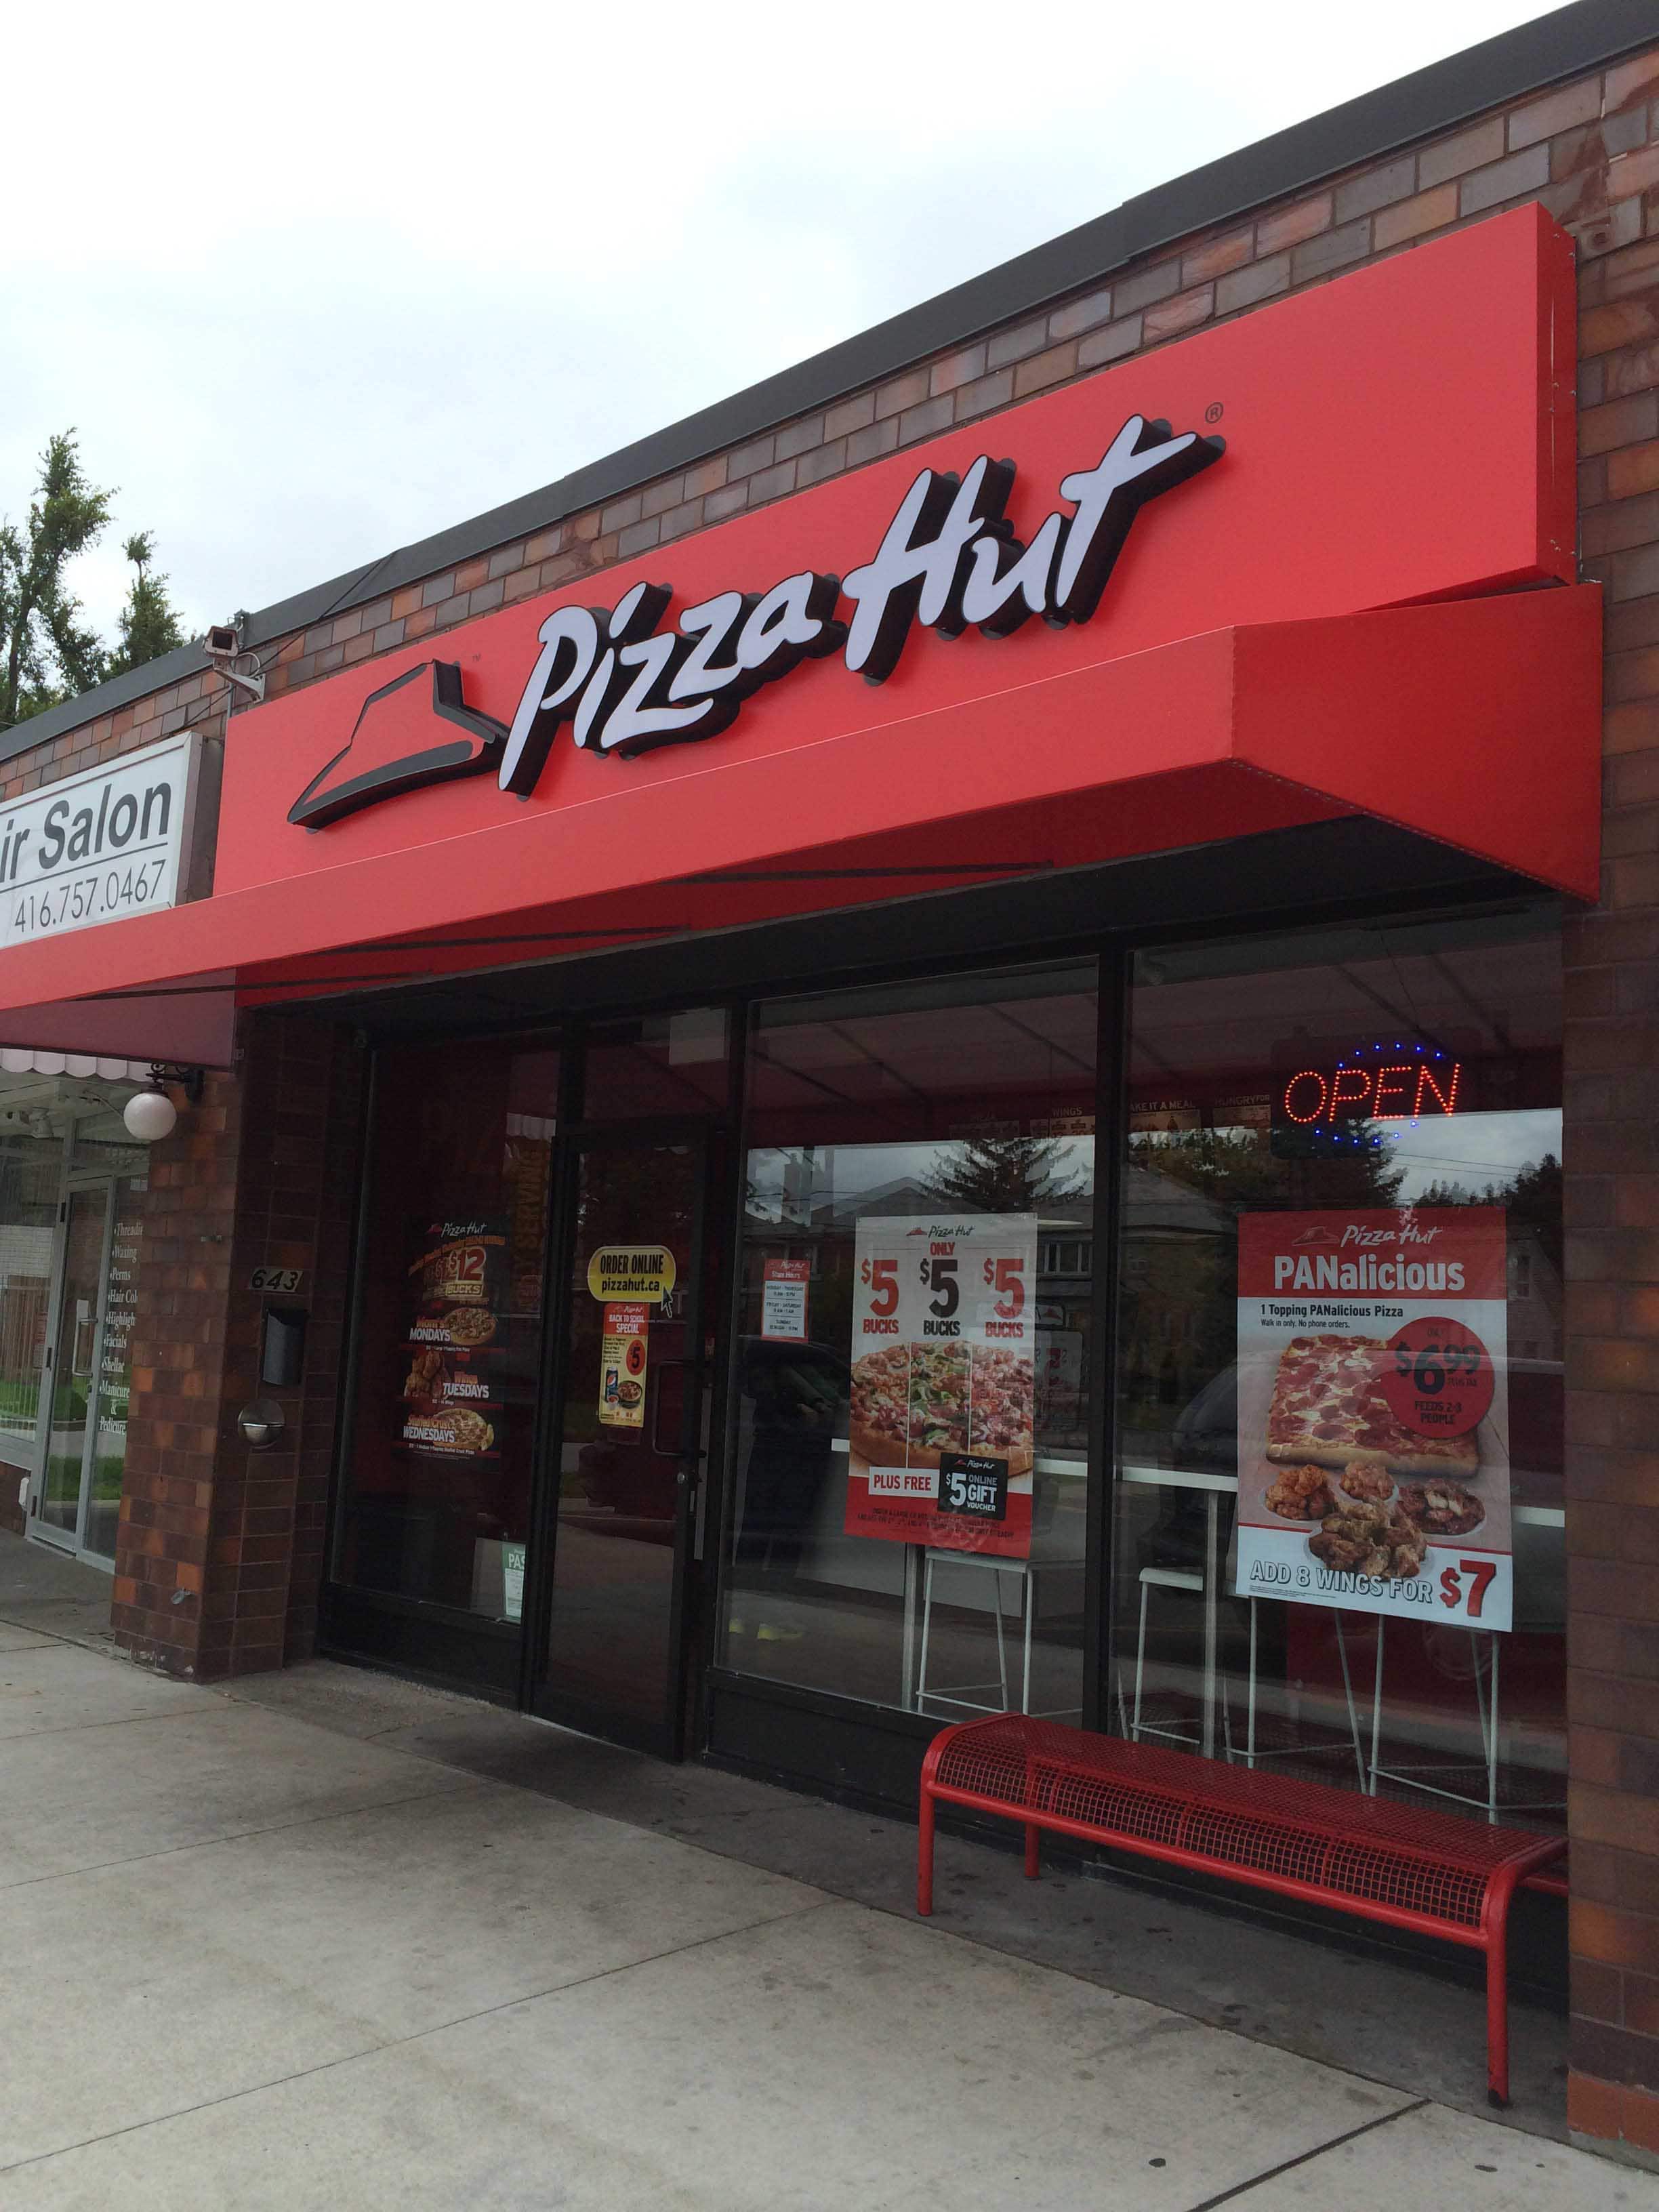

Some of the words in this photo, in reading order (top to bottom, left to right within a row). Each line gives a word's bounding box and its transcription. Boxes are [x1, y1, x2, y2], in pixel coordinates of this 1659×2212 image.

[498, 570, 837, 796] Pizza
[842, 414, 1210, 678] Hut
[39, 782, 171, 869] Salon
[15, 859, 166, 933] 416.757.0467
[1285, 1062, 1461, 1123] OPEN
[1128, 1102, 1148, 1112] AKE
[441, 1221, 465, 1237] Pizza
[466, 1221, 487, 1235] Hut
[928, 1225, 954, 1237] Pizza
[955, 1225, 975, 1236] Hut
[1340, 1225, 1395, 1248] Pizza
[1396, 1223, 1443, 1245] Hut
[114, 1246, 137, 1263] Waxing
[930, 1242, 956, 1256] ONLY
[600, 1255, 629, 1275] ORDER
[632, 1254, 663, 1274] ONLINE
[1274, 1254, 1465, 1291] PANalicious
[112, 1267, 130, 1281] Perms
[251, 1269, 298, 1290] 643
[447, 1284, 480, 1295] BUCKS
[602, 1277, 659, 1294] pizzahut.ca
[861, 1258, 899, 1317] $5
[920, 1258, 960, 1318] $5
[984, 1258, 1025, 1319] $5
[110, 1289, 125, 1303] Hair
[609, 1314, 622, 1322] BACK
[623, 1314, 629, 1322] TO
[1261, 1304, 1265, 1315] 1
[1269, 1304, 1307, 1317] Topping
[1310, 1305, 1371, 1317] PANalicious
[1374, 1305, 1404, 1317] Pizza
[616, 1322, 639, 1334] SPECIAL
[863, 1319, 900, 1334] BUCKS
[924, 1320, 961, 1336] BUCKS
[985, 1322, 1024, 1338] BUCKS
[1261, 1319, 1274, 1327] Walk
[1283, 1319, 1296, 1329] only.
[1298, 1319, 1307, 1328] No
[1308, 1319, 1327, 1329] phone
[1328, 1320, 1351, 1329] orders.
[106, 1334, 127, 1349] Facials
[409, 1328, 450, 1342] MONDAYS
[103, 1356, 125, 1372] Shellac
[101, 1380, 129, 1399] Manicure
[443, 1382, 489, 1399] TUESDAYS
[110, 1402, 117, 1415] &
[1414, 1401, 1443, 1412] FEEDS
[99, 1416, 126, 1435] Pedicure
[403, 1426, 455, 1443] WEDNESDAYS
[874, 1475, 901, 1490] PLUS
[904, 1475, 932, 1491] FREE
[968, 1475, 998, 1486] ONLINE
[945, 1472, 966, 1507] $5
[968, 1484, 998, 1504] GIFT
[966, 1501, 996, 1512] VOUCHER
[1250, 1560, 1292, 1584] ADD
[1296, 1565, 1311, 1587] 8
[1316, 1568, 1383, 1597] WINGS
[1389, 1577, 1433, 1603] FOR
[1439, 1559, 1496, 1617] $7
